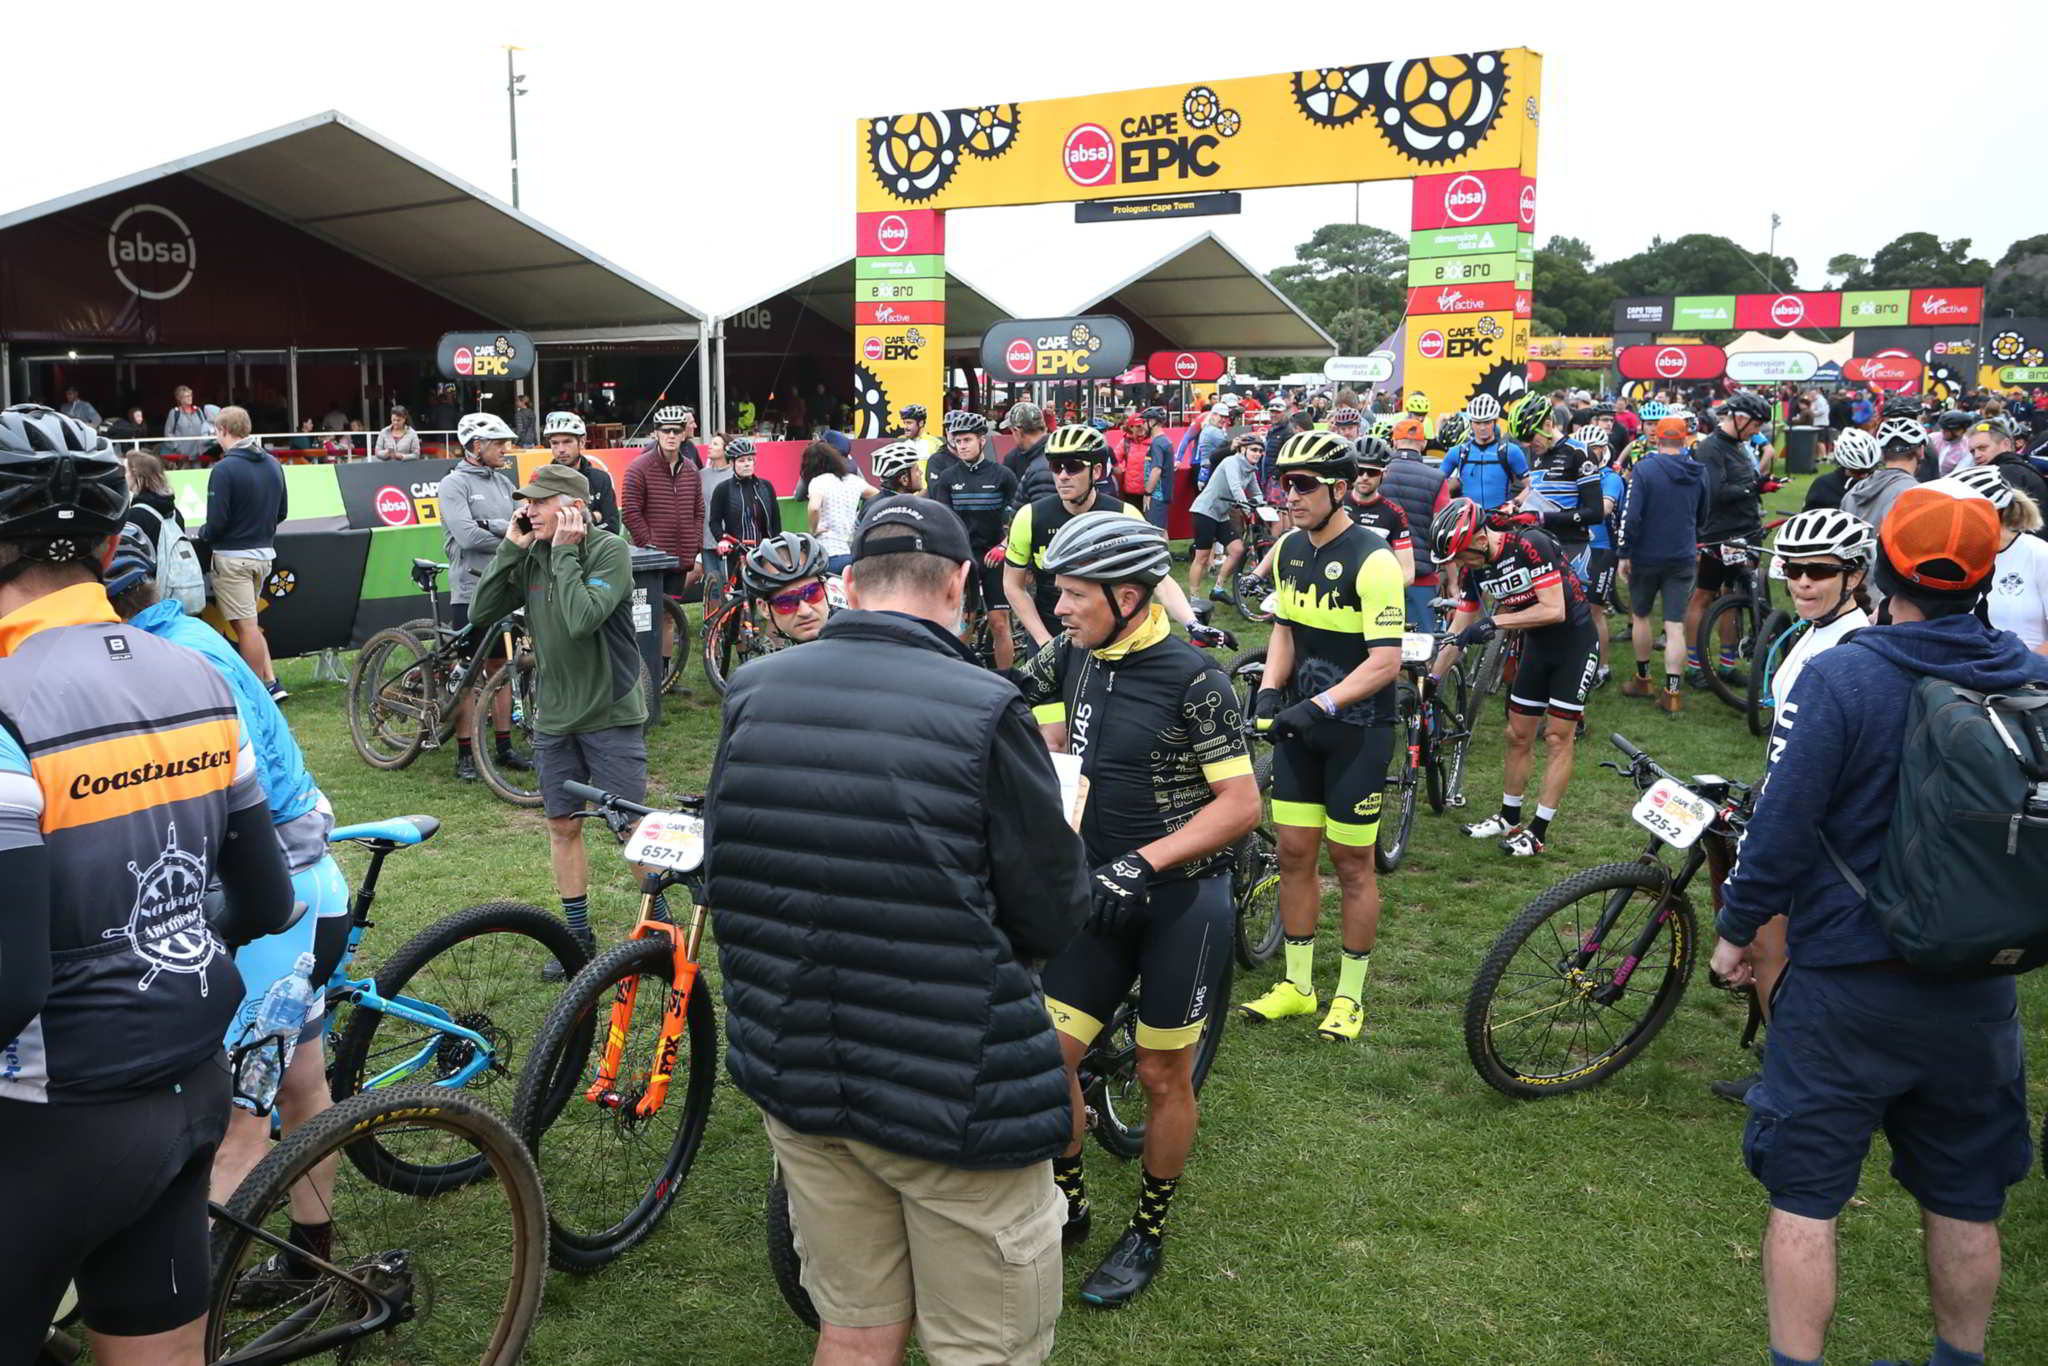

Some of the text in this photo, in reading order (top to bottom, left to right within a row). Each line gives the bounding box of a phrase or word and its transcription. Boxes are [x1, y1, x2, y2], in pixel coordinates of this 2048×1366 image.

[1120, 112, 1179, 138] CAPE
[1070, 143, 1108, 163] absa
[1121, 134, 1221, 184] EPIC
[1450, 189, 1483, 205] absa
[1113, 201, 1195, 215] Prologue: Cape Town
[882, 226, 905, 239] absa
[1434, 233, 1477, 245] dimension
[119, 231, 187, 264] absa
[1458, 241, 1477, 250] data
[1435, 261, 1491, 280] exxaro
[872, 282, 913, 297] exxaro
[1436, 286, 1484, 312] Virgin active
[1775, 304, 1800, 315] absa
[1852, 301, 1898, 315] exxaro
[1939, 305, 1968, 314] active
[888, 314, 910, 322] active
[1447, 327, 1475, 338] CAPE
[884, 336, 905, 345] CAPE
[1036, 335, 1068, 350] CAPE
[1447, 337, 1493, 357] EPIC
[474, 345, 496, 356] CAPE
[884, 345, 918, 360] EPIC
[1009, 350, 1030, 362] absa
[474, 356, 509, 375] EPIC
[1036, 349, 1090, 375] EPIC
[1177, 360, 1195, 370] absa
[1660, 356, 1683, 367] absa
[1738, 359, 1785, 368] dimension
[1764, 367, 1785, 375] data
[1877, 369, 1905, 378] active
[410, 481, 441, 498] CAP
[381, 500, 407, 512] absa
[872, 506, 924, 521] COMMISSAIRE
[1531, 562, 1553, 577] BH
[1072, 702, 1092, 756] RJ45
[1643, 809, 1682, 839] 225-2
[641, 844, 684, 862] 657-1
[1095, 874, 1134, 897] FOX
[1191, 985, 1207, 1018] RJ45
[659, 1035, 681, 1075] FOX
[1515, 1055, 1611, 1086] CROSSMAX
